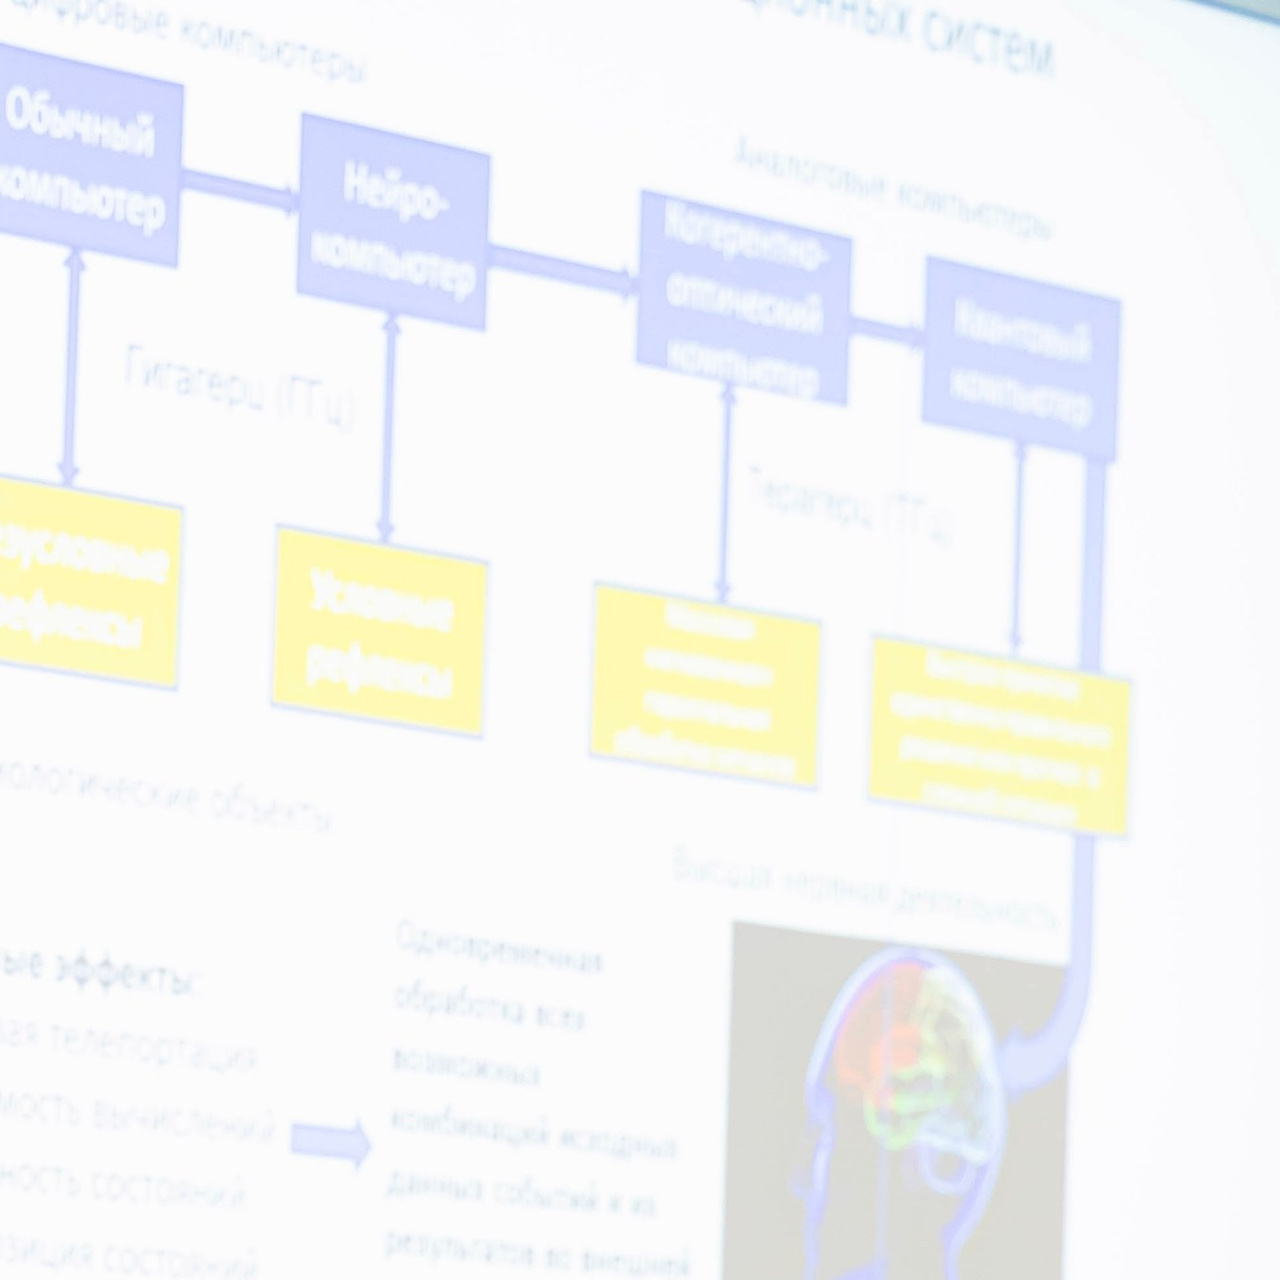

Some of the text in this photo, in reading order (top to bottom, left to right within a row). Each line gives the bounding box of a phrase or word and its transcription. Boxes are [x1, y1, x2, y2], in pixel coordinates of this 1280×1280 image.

[180, 16, 368, 86] компьютеры
[6, 85, 156, 157] Обычный
[343, 159, 451, 223] Нейро-
[311, 231, 477, 301] компьютер
